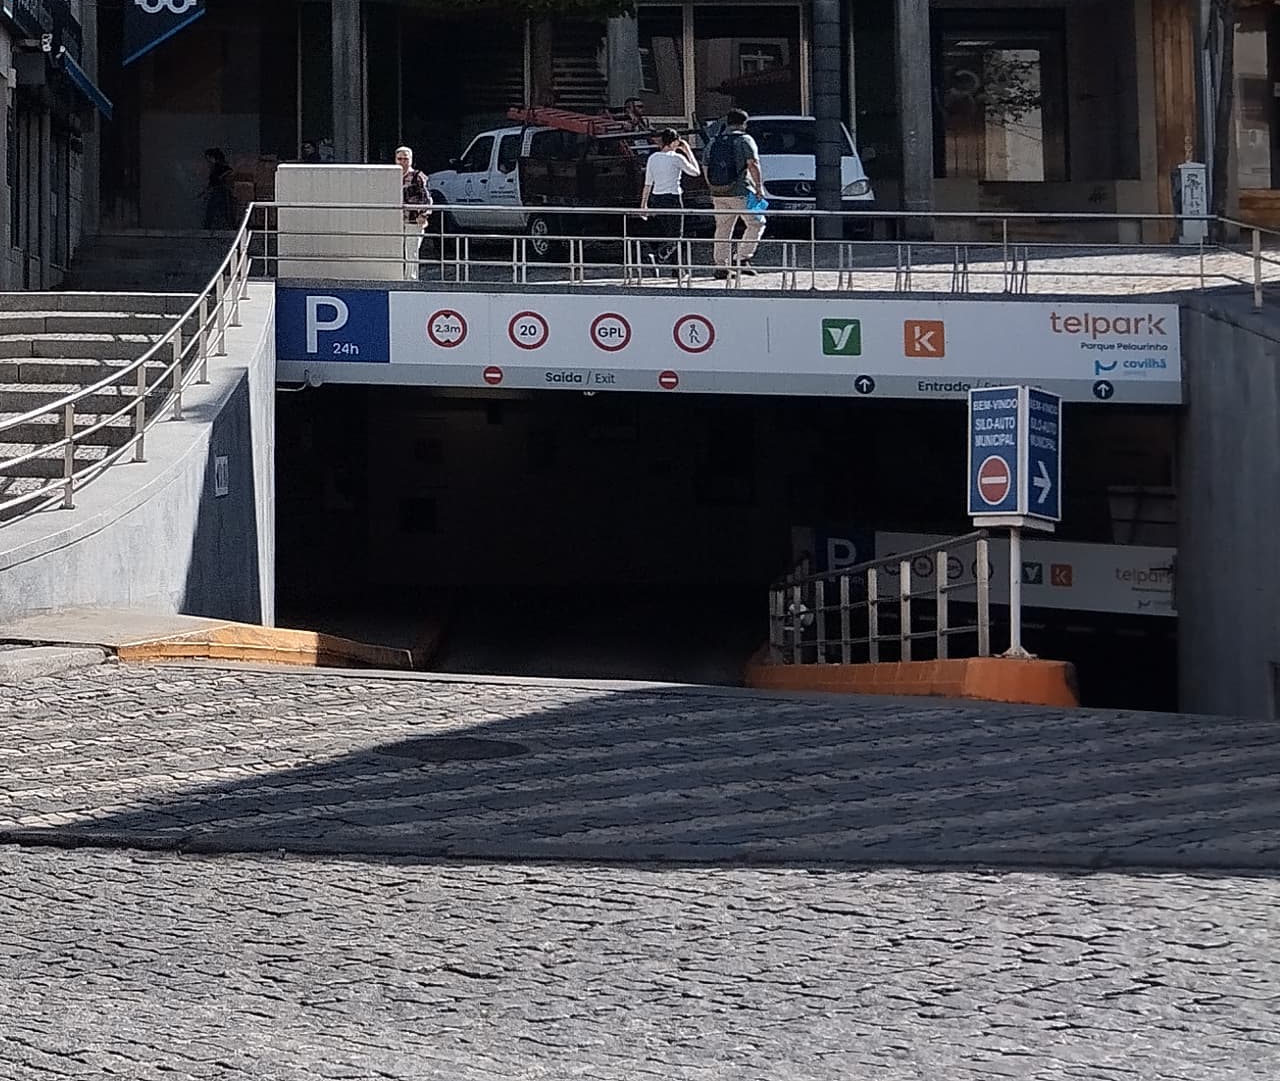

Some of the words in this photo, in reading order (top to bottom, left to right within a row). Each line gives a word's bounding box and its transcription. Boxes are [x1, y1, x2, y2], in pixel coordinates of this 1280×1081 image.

[305, 296, 349, 353] P
[519, 324, 537, 337] 20
[1050, 311, 1167, 340] telpark
[597, 327, 625, 340] GPL
[332, 342, 360, 355] 24h
[1081, 342, 1115, 352] Parque
[545, 372, 582, 384] Saída
[595, 374, 616, 384] Exit
[975, 417, 1016, 431] SILO-AUTO
